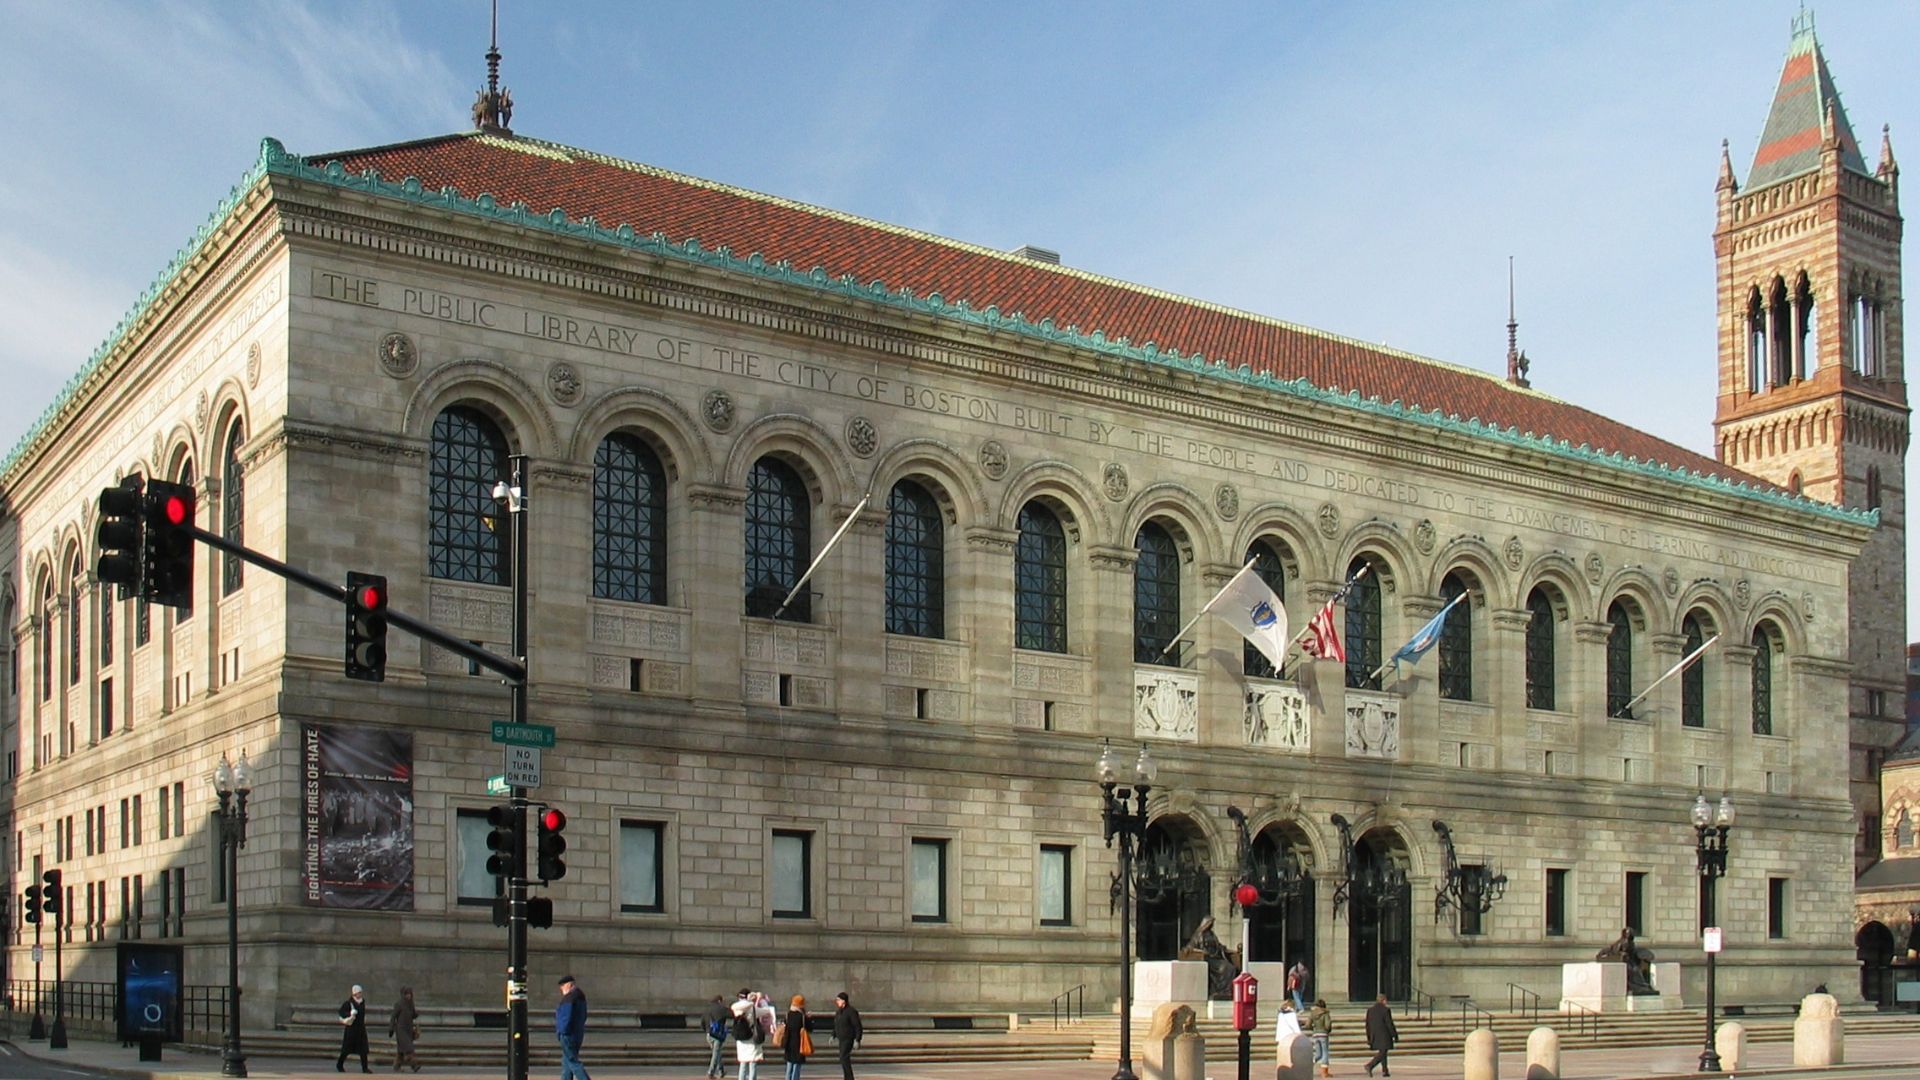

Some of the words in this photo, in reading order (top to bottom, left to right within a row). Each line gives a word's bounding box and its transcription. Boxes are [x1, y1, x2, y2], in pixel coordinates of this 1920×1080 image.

[229, 281, 278, 342] CITIZENS
[322, 273, 379, 306] THE
[403, 288, 497, 328] PUBLIC
[523, 312, 638, 353] LIBRARY
[656, 338, 691, 363] OF
[713, 348, 761, 378] THE
[778, 361, 838, 391] CITY
[857, 376, 888, 400] OF
[903, 385, 999, 422] BOSTON
[1014, 407, 1073, 437] BUILT
[1088, 421, 1116, 445] BY
[1131, 430, 1174, 457] THE
[1187, 442, 1257, 473] PEOPLE
[1271, 460, 1309, 482] AND
[1324, 469, 1419, 504] DEDICATED
[1433, 490, 1455, 510] TO
[1464, 496, 1496, 521] THE
[1505, 506, 1610, 541] ADVANCEMENT
[1619, 528, 1638, 546] OF
[1647, 532, 1711, 561] LEARNING
[307, 729, 319, 762] HATE
[506, 726, 543, 743] DARTMOUTH
[512, 761, 535, 771] TURN
[516, 750, 531, 759] NO
[307, 763, 319, 780] OF
[507, 772, 519, 781] ON
[522, 773, 539, 783] RED
[307, 780, 319, 814] FIRES
[307, 816, 319, 841] THE
[308, 843, 320, 900] FIGHTING
